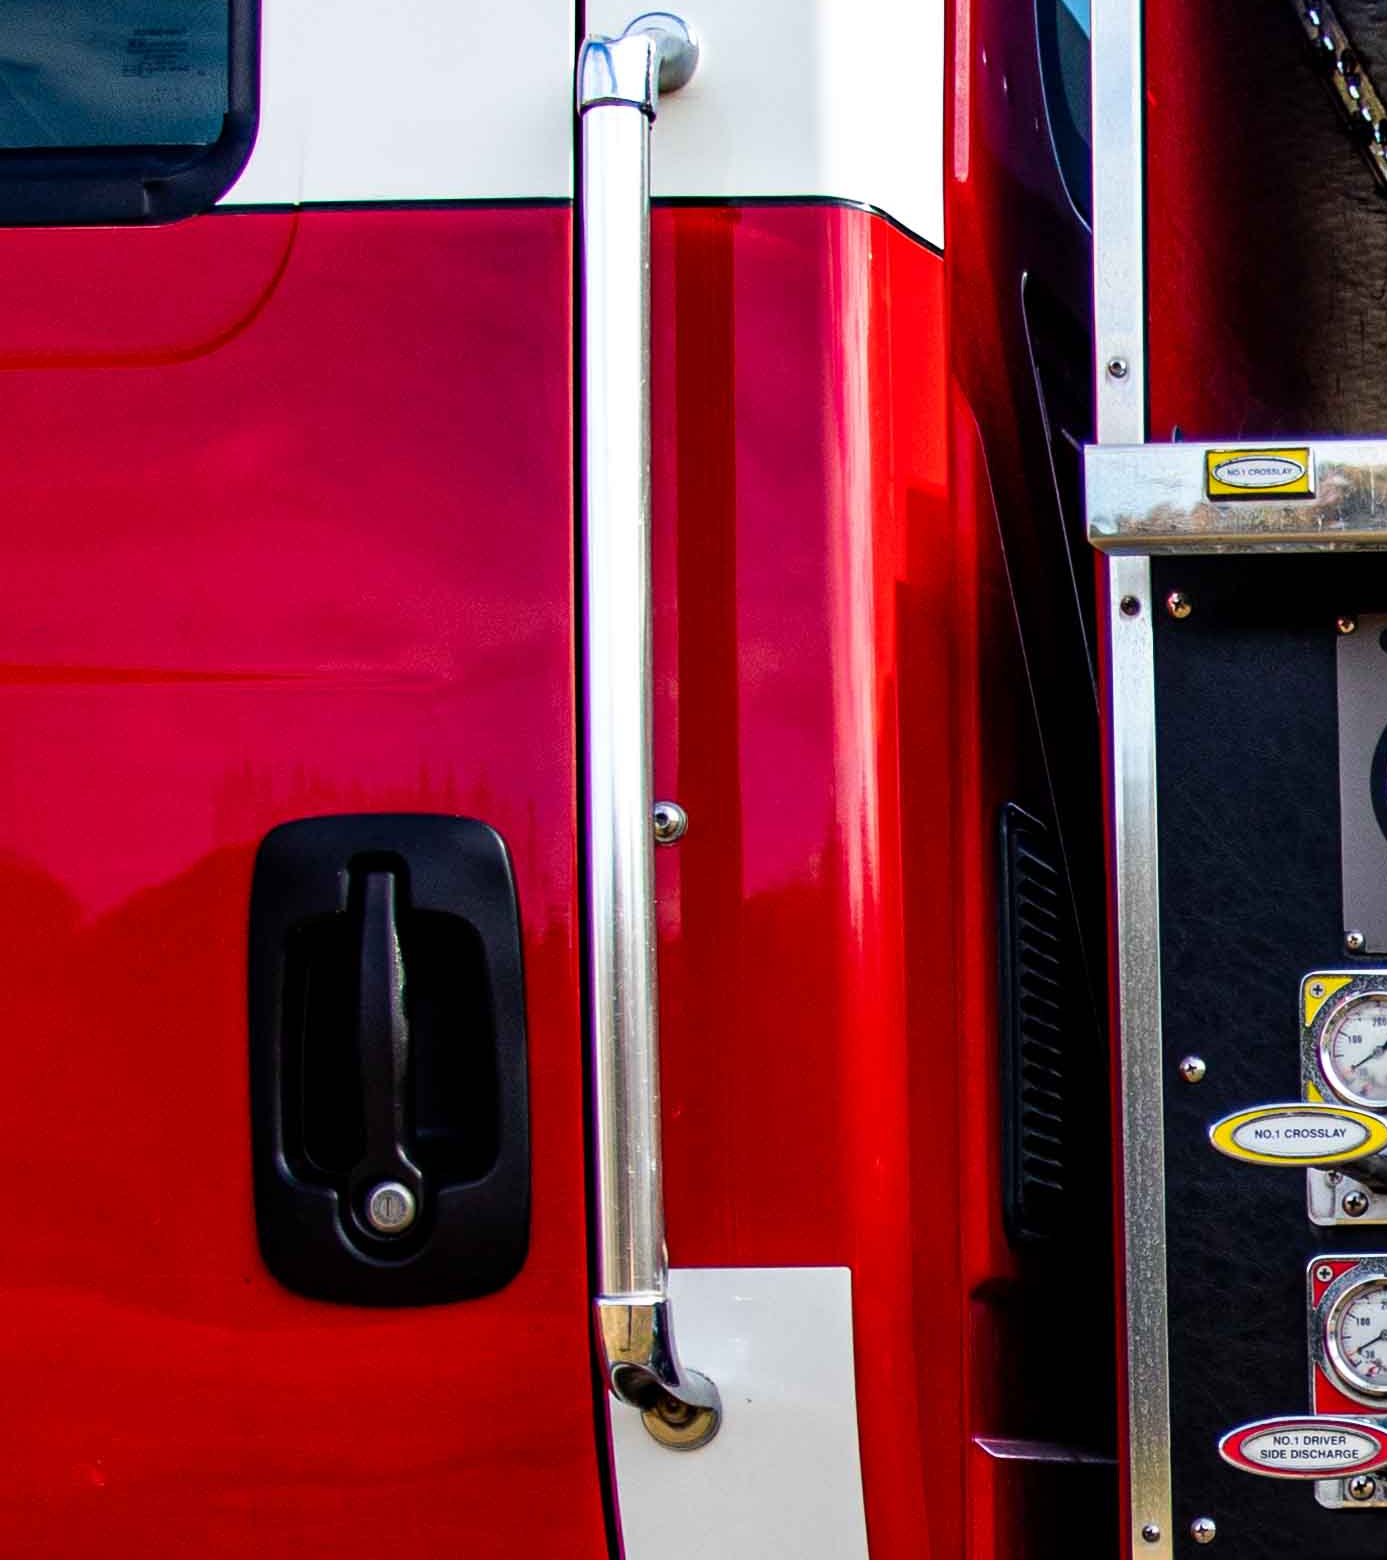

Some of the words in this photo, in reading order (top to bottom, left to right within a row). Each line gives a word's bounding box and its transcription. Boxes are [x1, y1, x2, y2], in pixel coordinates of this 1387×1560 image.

[1248, 466, 1293, 476] CROSSLAY
[1254, 1129, 1281, 1139] NO.1
[1284, 1128, 1346, 1139] CROSSLAY
[1273, 1436, 1299, 1446] NO.1
[1303, 1436, 1346, 1446] DRIVER
[1260, 1450, 1287, 1460] SIDE
[1290, 1449, 1359, 1459] DISCHARGE
